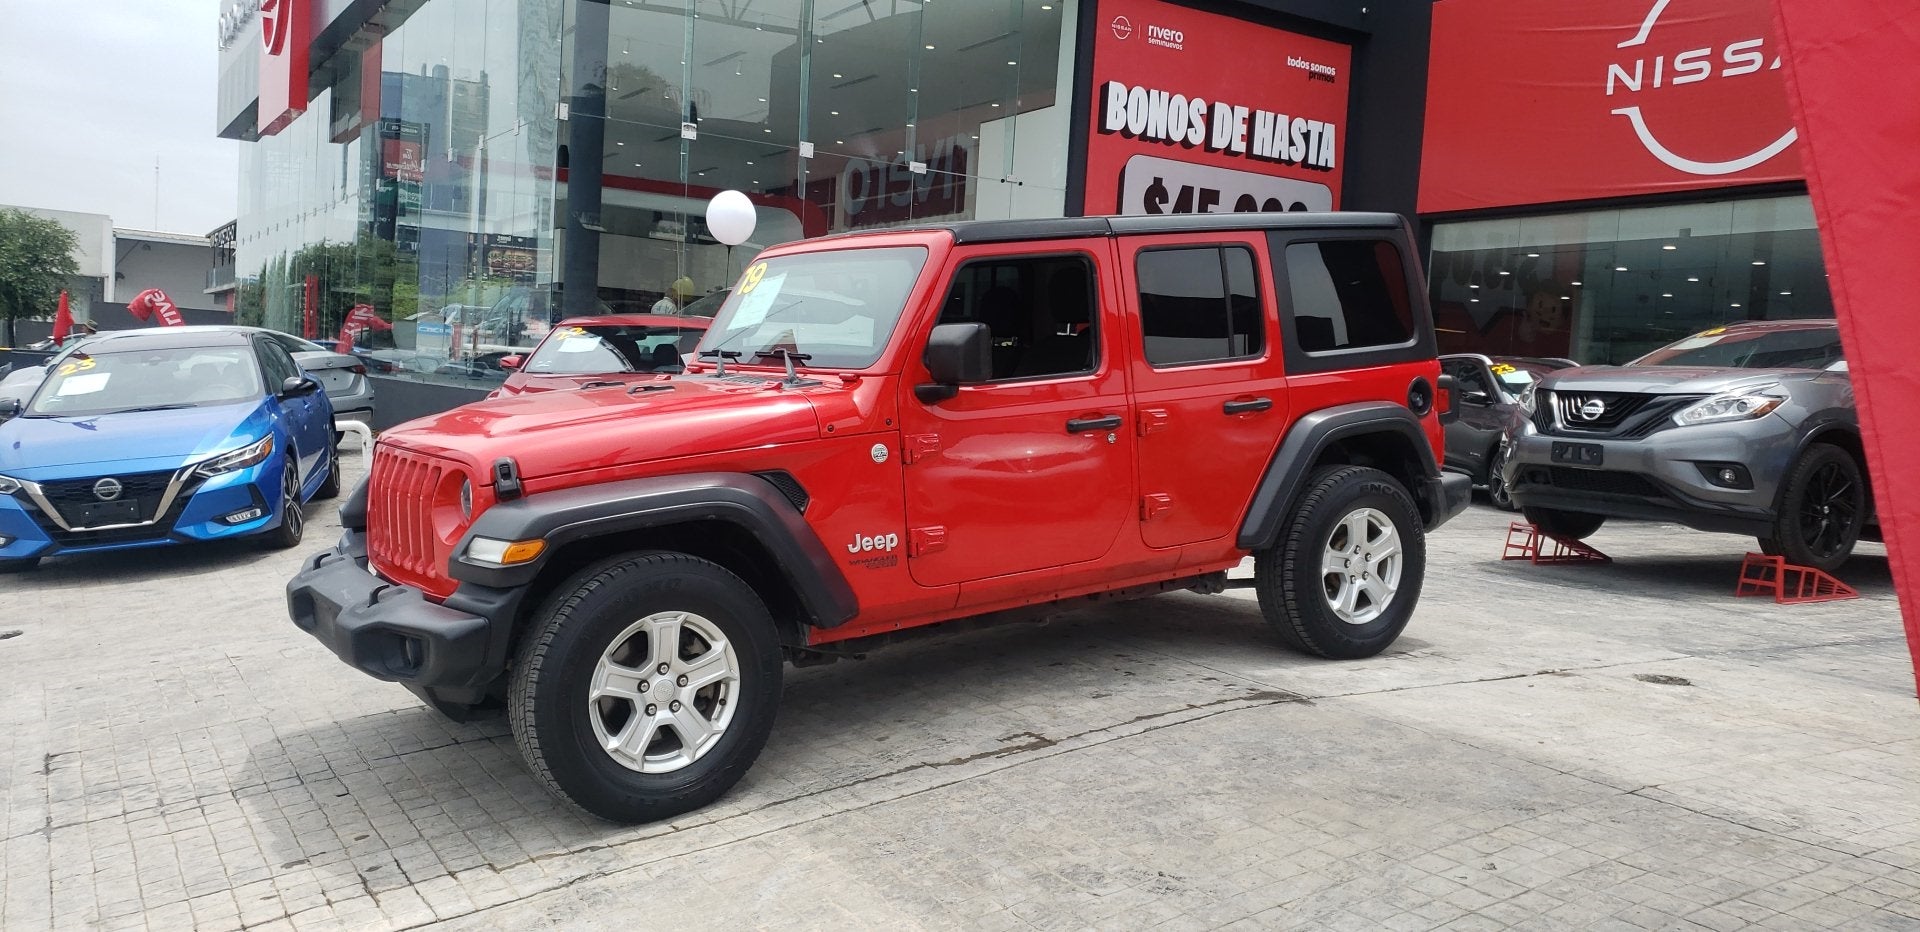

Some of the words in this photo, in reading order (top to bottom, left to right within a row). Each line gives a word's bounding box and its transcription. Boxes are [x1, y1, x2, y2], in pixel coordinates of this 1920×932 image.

[1148, 24, 1184, 43] rivero
[1148, 37, 1183, 50] seminuevos
[1287, 55, 1310, 70] todos
[1310, 62, 1336, 76] somos
[1606, 38, 1782, 96] NISS
[1308, 71, 1335, 84] primos
[1102, 80, 1208, 147] BONOS
[1209, 101, 1249, 154] DE
[1250, 110, 1336, 169] HASTA
[737, 262, 768, 295] 19
[59, 357, 96, 377] 23
[847, 532, 899, 553] Jeep
